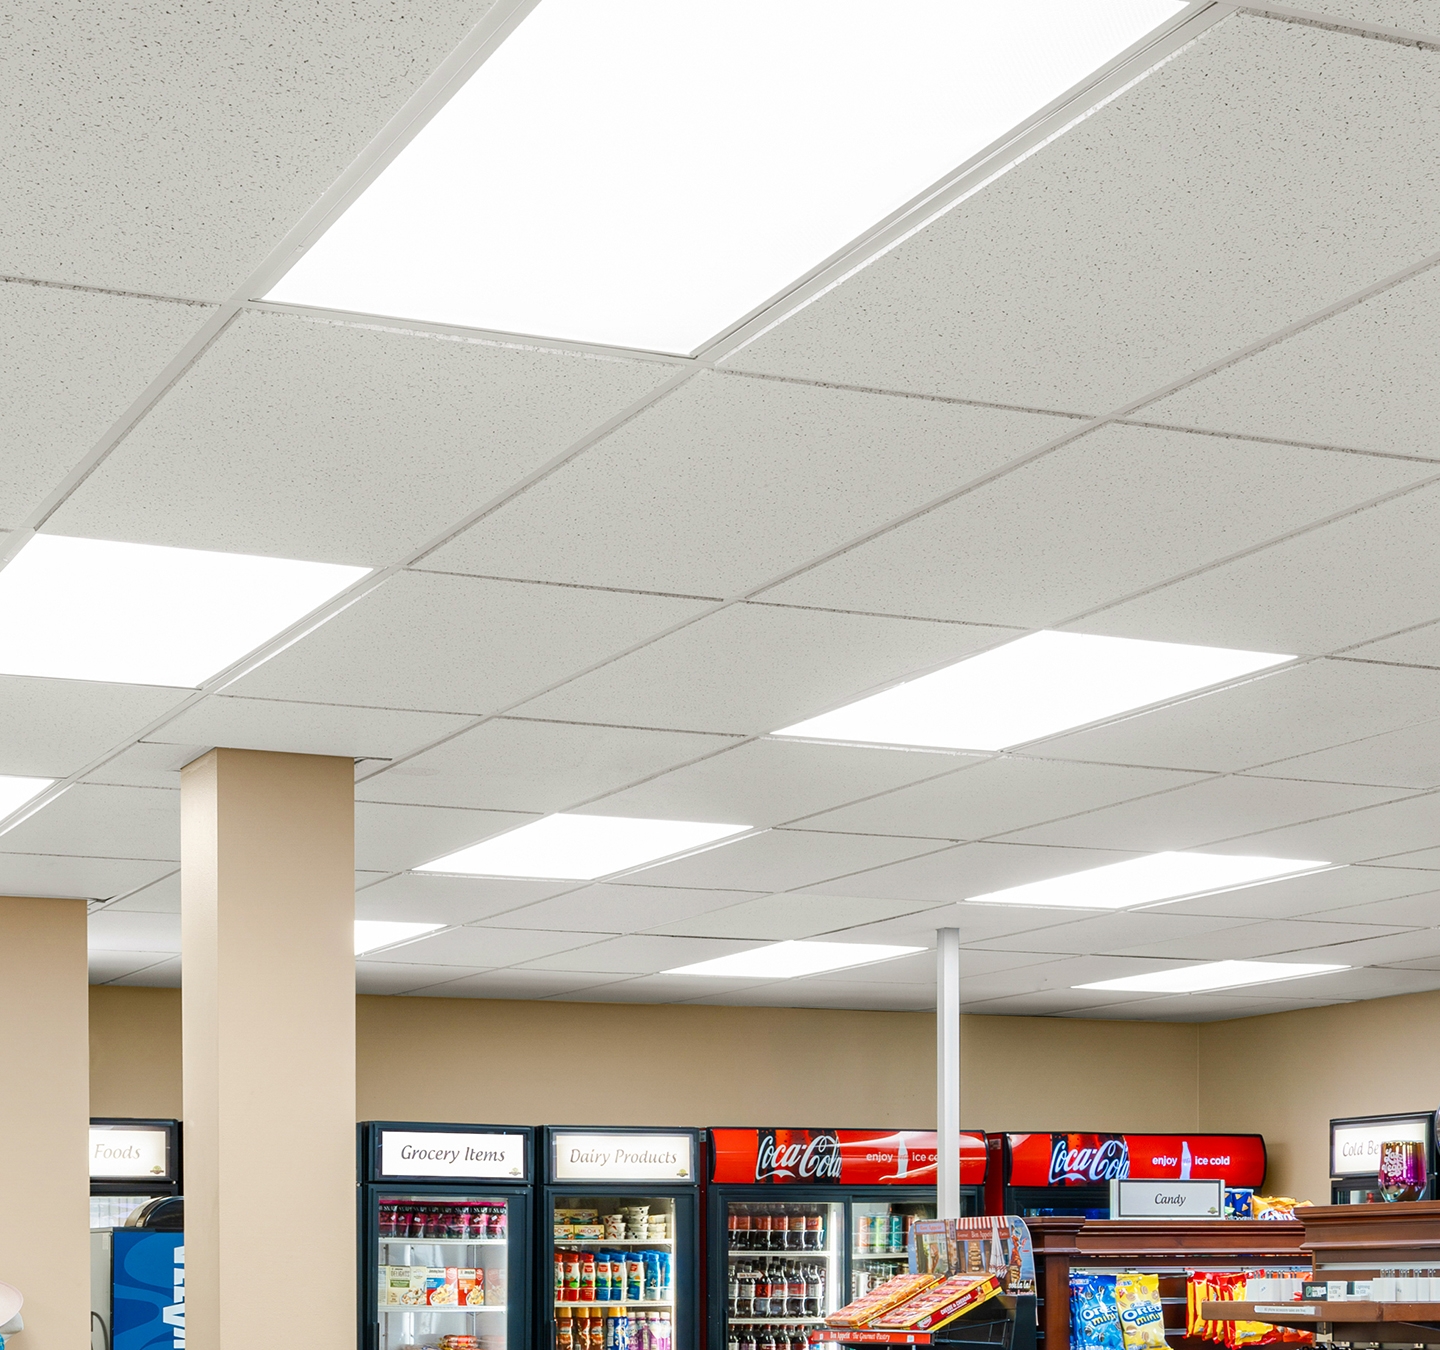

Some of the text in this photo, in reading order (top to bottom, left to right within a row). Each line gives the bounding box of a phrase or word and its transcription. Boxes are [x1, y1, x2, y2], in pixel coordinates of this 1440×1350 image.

[94, 1143, 141, 1160] Foods
[401, 1144, 505, 1164] Grocery Items
[1342, 1140, 1379, 1157] Cold Be
[570, 1148, 677, 1167] Dairy Products
[755, 1135, 843, 1181] Coca-Cola
[866, 1152, 894, 1163] enjoy
[912, 1151, 926, 1162] ice
[1049, 1140, 1230, 1184] Coca-Cola enjoy ice cold
[1154, 1193, 1187, 1206] Candy
[1123, 1305, 1162, 1321] OREO
[1136, 1312, 1162, 1326] mini
[839, 1332, 850, 1340] Appetit
[859, 1333, 876, 1341] Gourmet
[876, 1333, 890, 1343] Pastry
